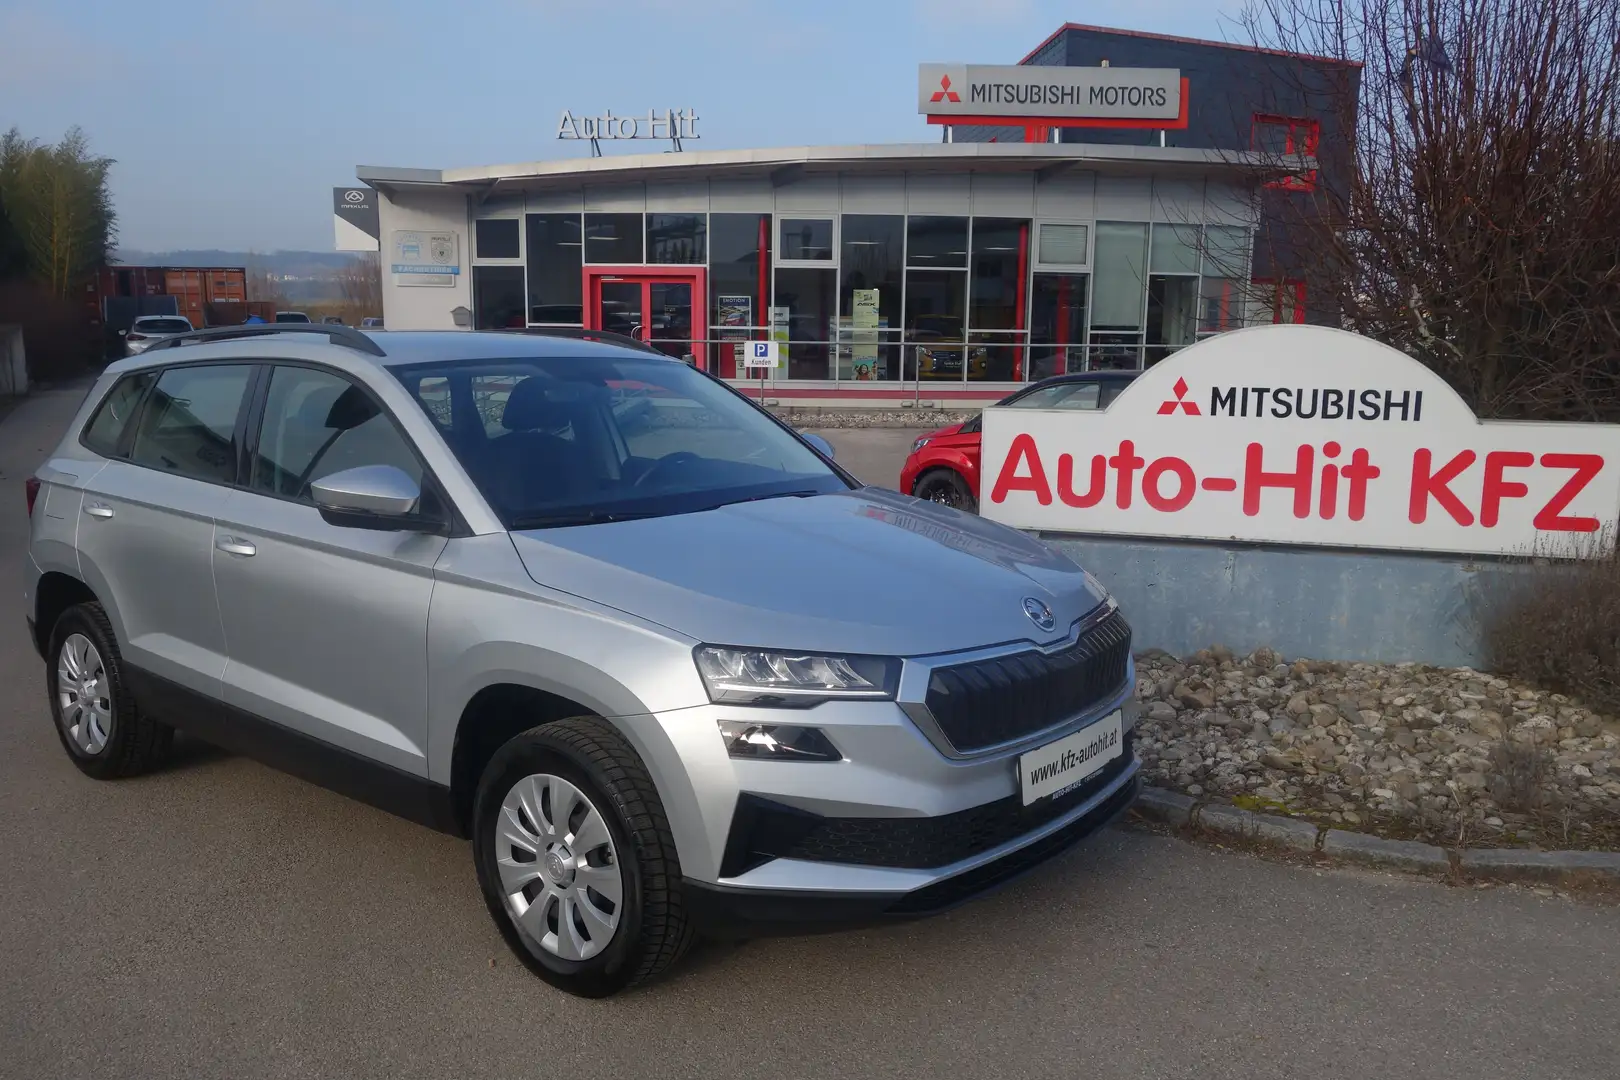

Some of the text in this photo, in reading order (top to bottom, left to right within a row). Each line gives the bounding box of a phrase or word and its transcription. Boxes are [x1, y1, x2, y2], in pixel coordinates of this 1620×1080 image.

[971, 83, 1167, 106] MITSUBISHI MOTORS
[556, 108, 701, 139] Auto Hit
[751, 358, 772, 366] Kunden
[757, 344, 766, 357] P
[1209, 386, 1424, 422] MITSUBISHI
[990, 433, 1606, 533] Auto-Hit KFZ
[1030, 727, 1118, 786] www.kfz-autohit.at
